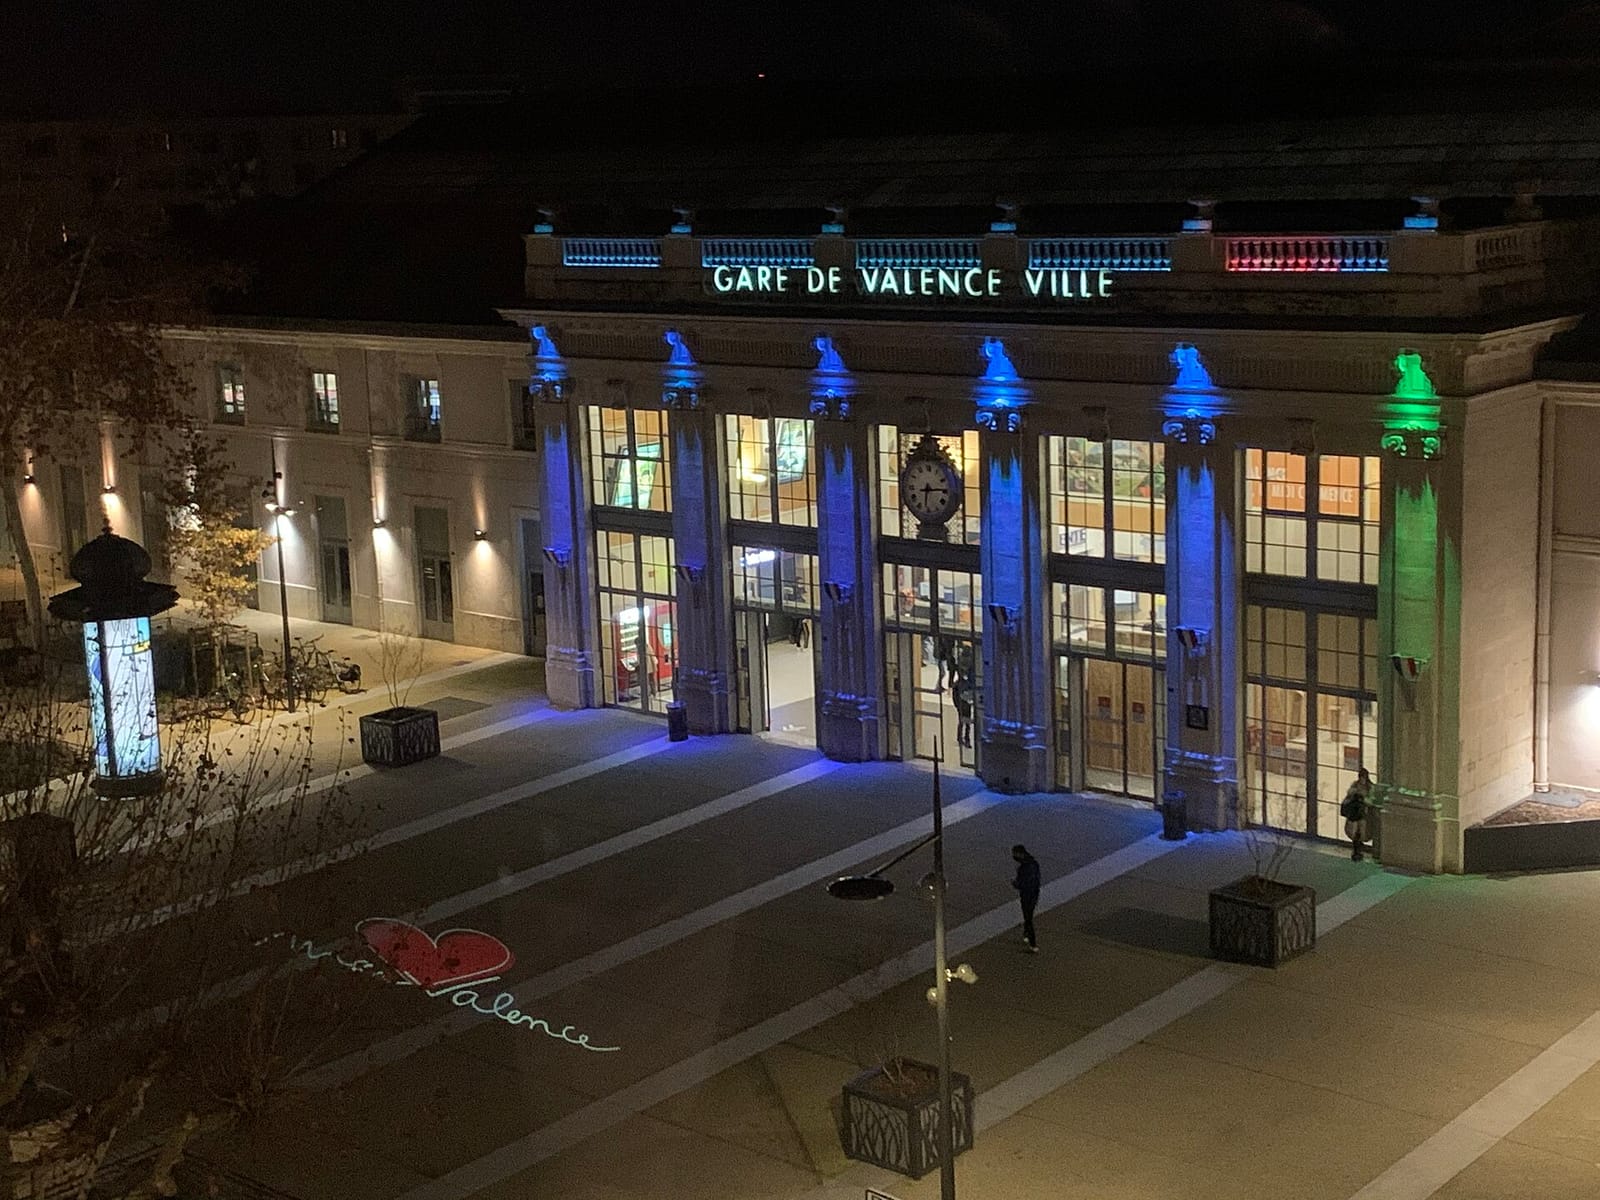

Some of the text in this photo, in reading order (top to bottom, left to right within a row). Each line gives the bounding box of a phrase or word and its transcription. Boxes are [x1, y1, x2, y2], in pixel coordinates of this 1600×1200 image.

[712, 265, 1113, 298] GARE DE VALENCE VILLE
